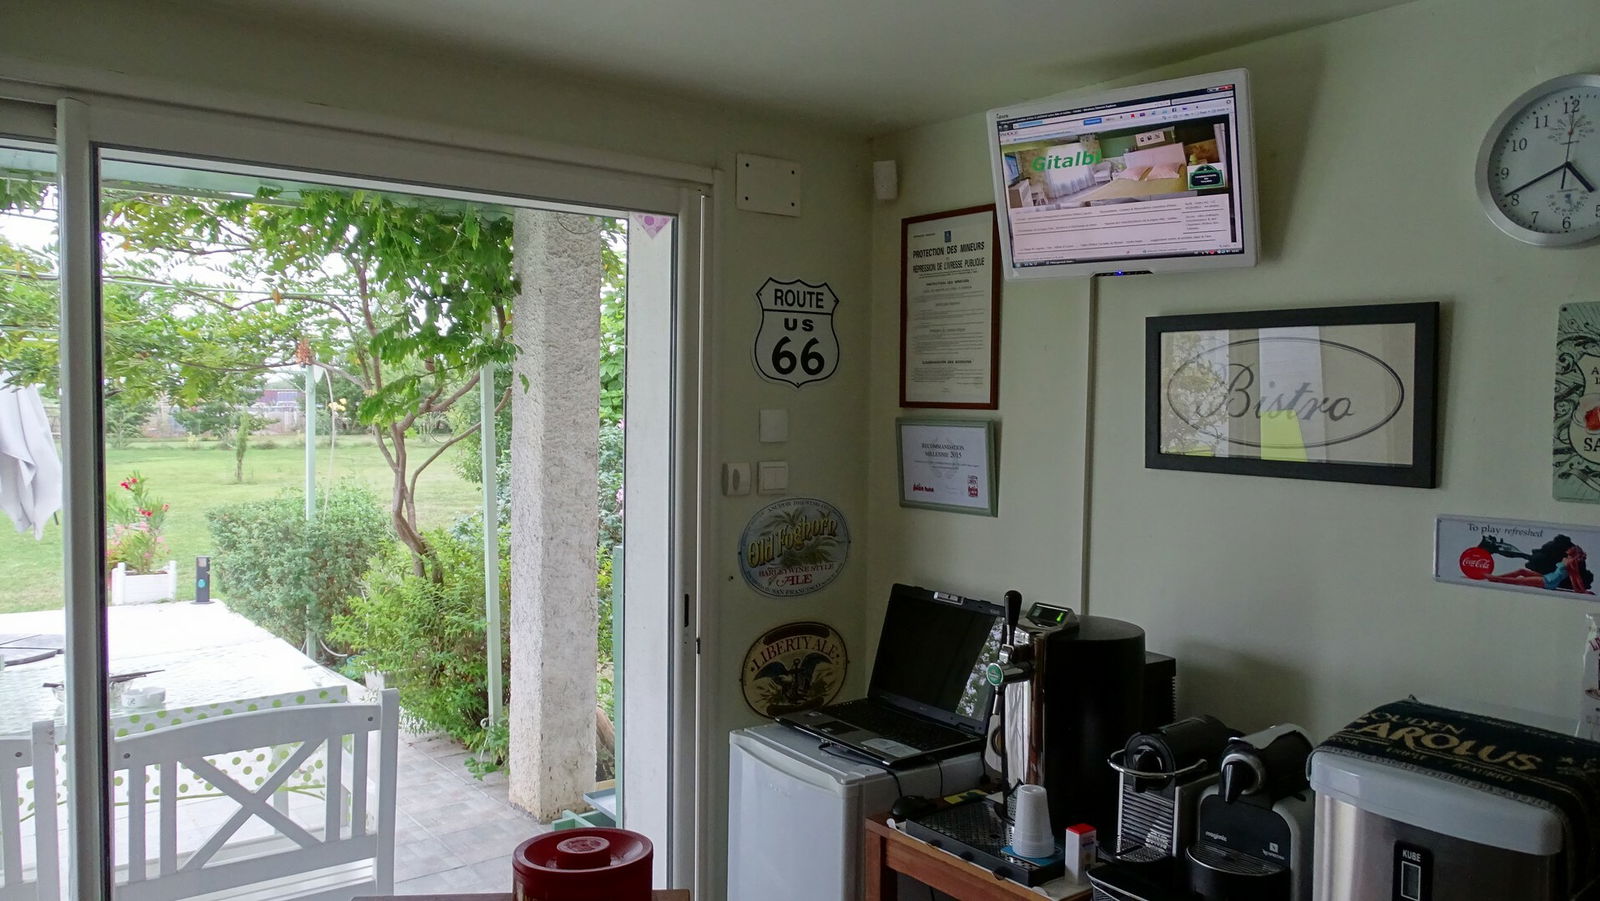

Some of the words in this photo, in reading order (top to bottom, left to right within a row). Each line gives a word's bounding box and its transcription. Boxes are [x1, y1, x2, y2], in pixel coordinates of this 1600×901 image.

[1563, 99, 1580, 115] 12
[1534, 115, 1549, 129] 11
[1511, 138, 1528, 152] 10
[1500, 167, 1510, 180] 9
[1511, 193, 1521, 207] 8
[1531, 211, 1539, 224] 7
[1562, 216, 1572, 229] 6
[912, 247, 944, 259] PROTECTION
[946, 245, 957, 255] DES
[960, 241, 985, 253] MINEURS
[937, 262, 943, 271] DE
[964, 257, 985, 268] PUBLIQUE
[774, 288, 824, 309] ROUTE
[783, 317, 814, 332] US
[771, 336, 825, 376] 66
[1196, 362, 1354, 423] Bistro
[1467, 523, 1479, 532] To
[1481, 524, 1502, 537] play
[1504, 526, 1544, 538] refreshed
[748, 537, 774, 569] Old
[777, 515, 838, 556] Foghorn
[778, 574, 813, 588] ALE
[752, 636, 812, 672] LIBERTY
[814, 638, 837, 660] ALE
[1402, 849, 1422, 863] KUBE
